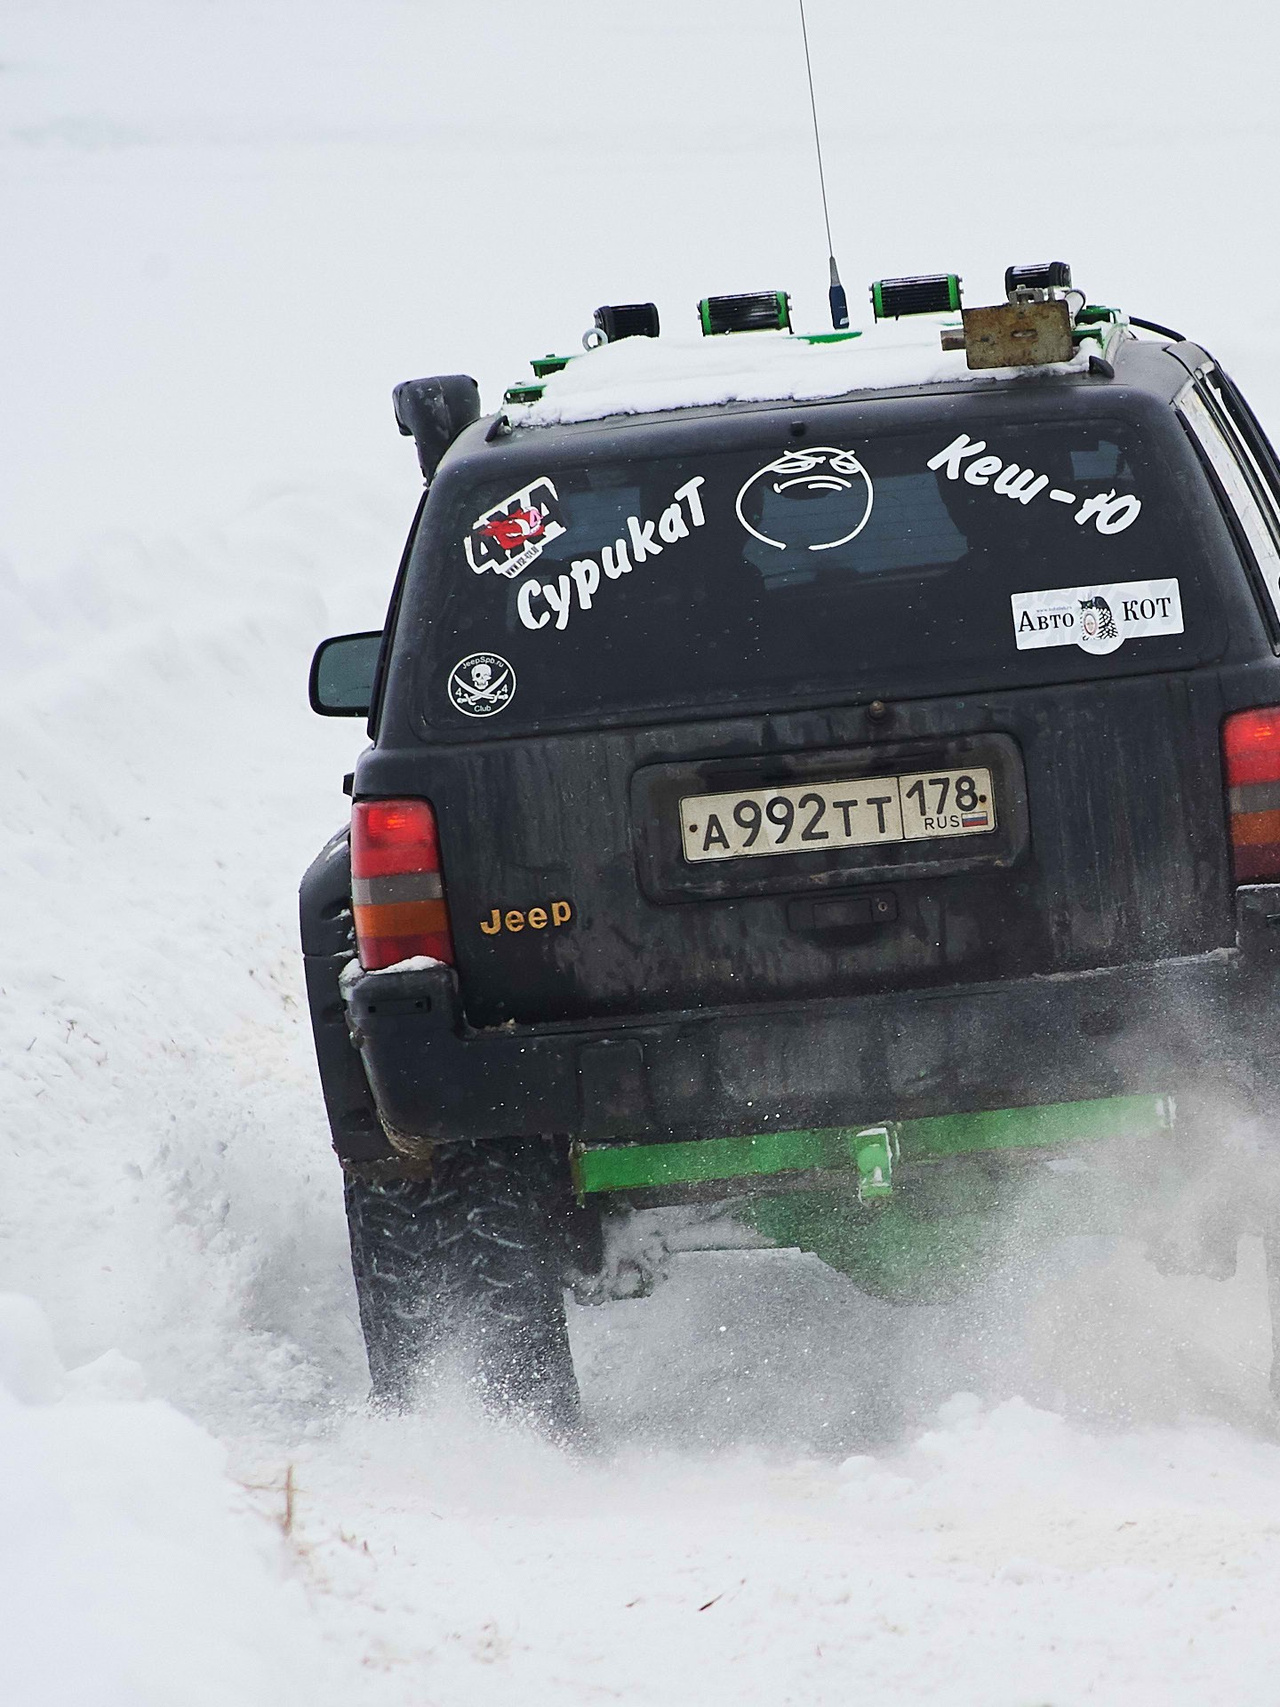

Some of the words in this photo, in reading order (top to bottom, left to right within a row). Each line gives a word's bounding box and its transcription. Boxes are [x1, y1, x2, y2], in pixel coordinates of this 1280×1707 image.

[906, 775, 979, 816] 178
[924, 814, 961, 830] RUS
[480, 901, 571, 934] Jeep
